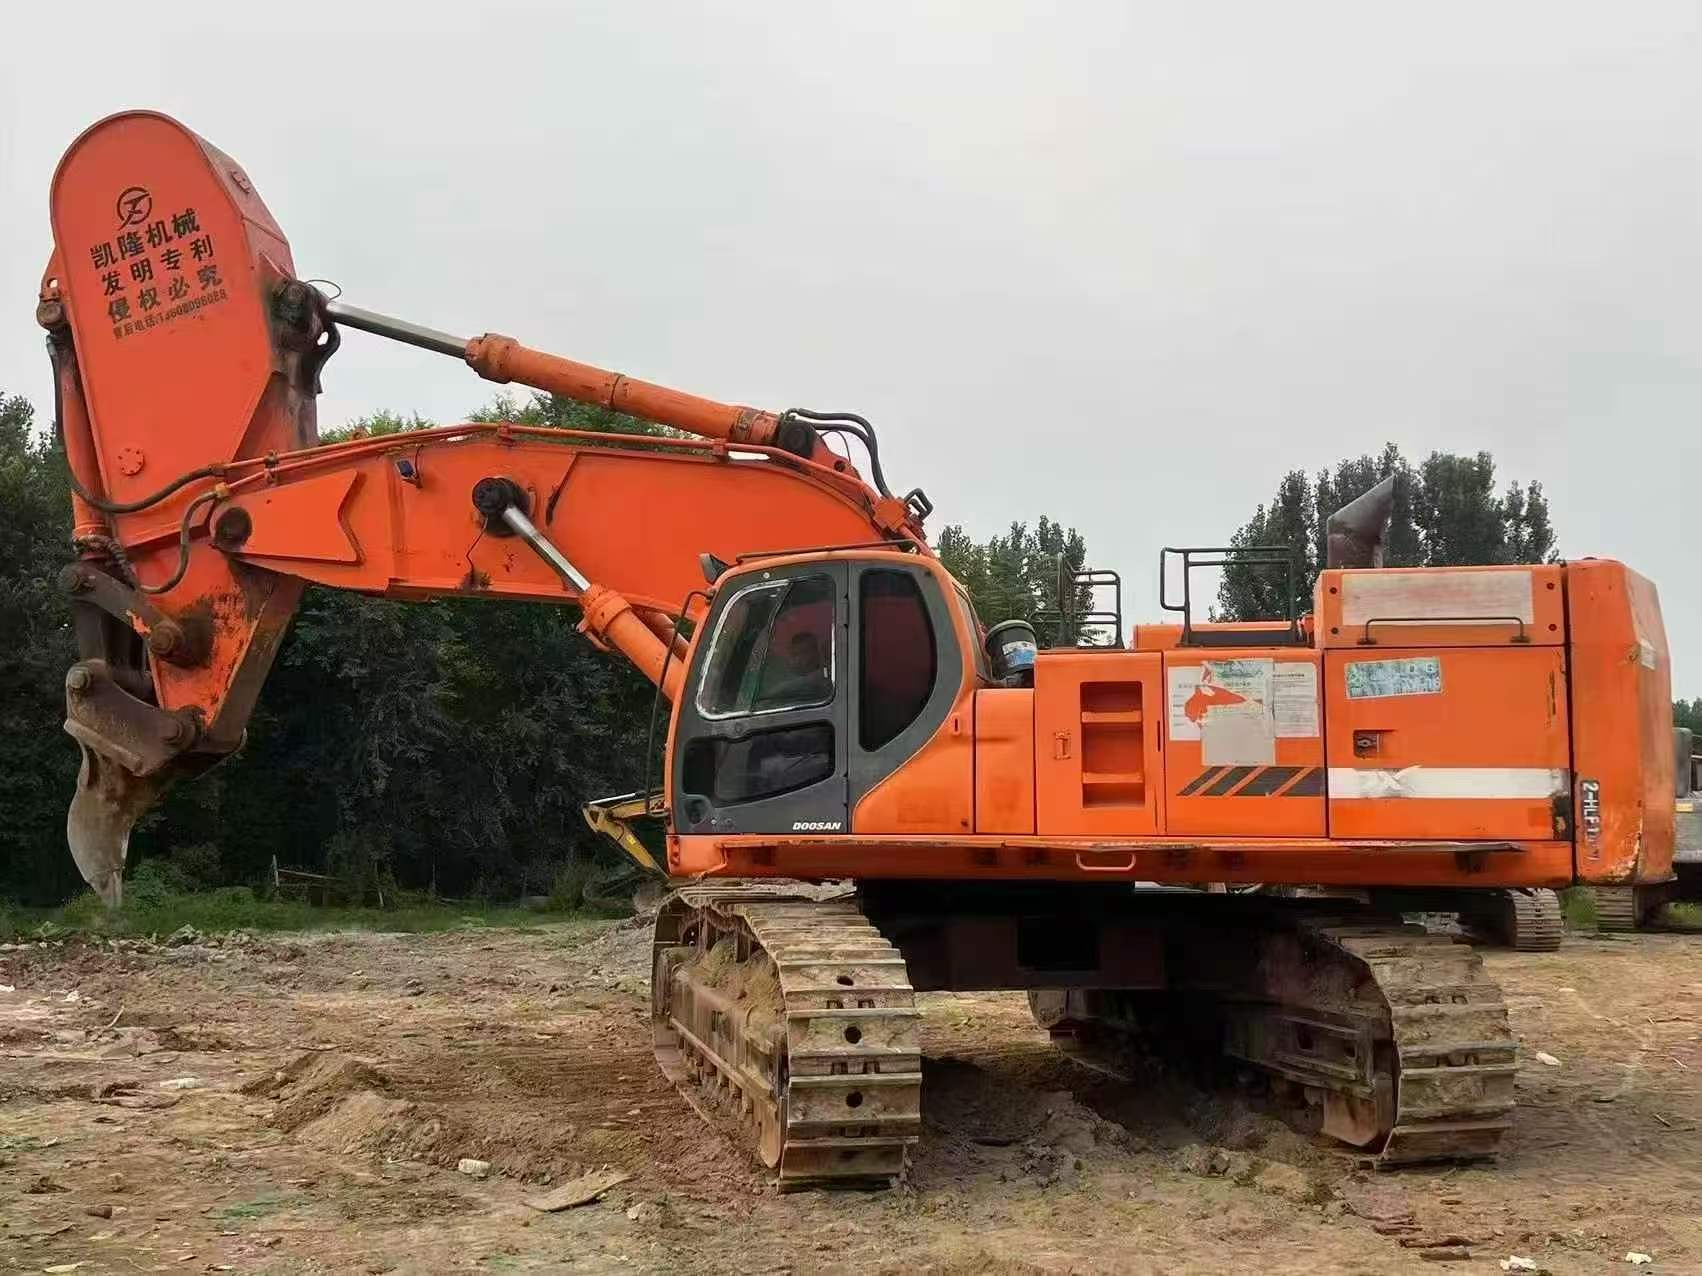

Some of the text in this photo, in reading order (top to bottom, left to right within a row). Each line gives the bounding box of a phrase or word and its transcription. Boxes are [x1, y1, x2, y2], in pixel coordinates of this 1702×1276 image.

[90, 208, 201, 270] 凯隆机械
[102, 235, 214, 296] 发明专利
[108, 264, 223, 324] 侵权必究
[792, 822, 842, 831] DOOSAN
